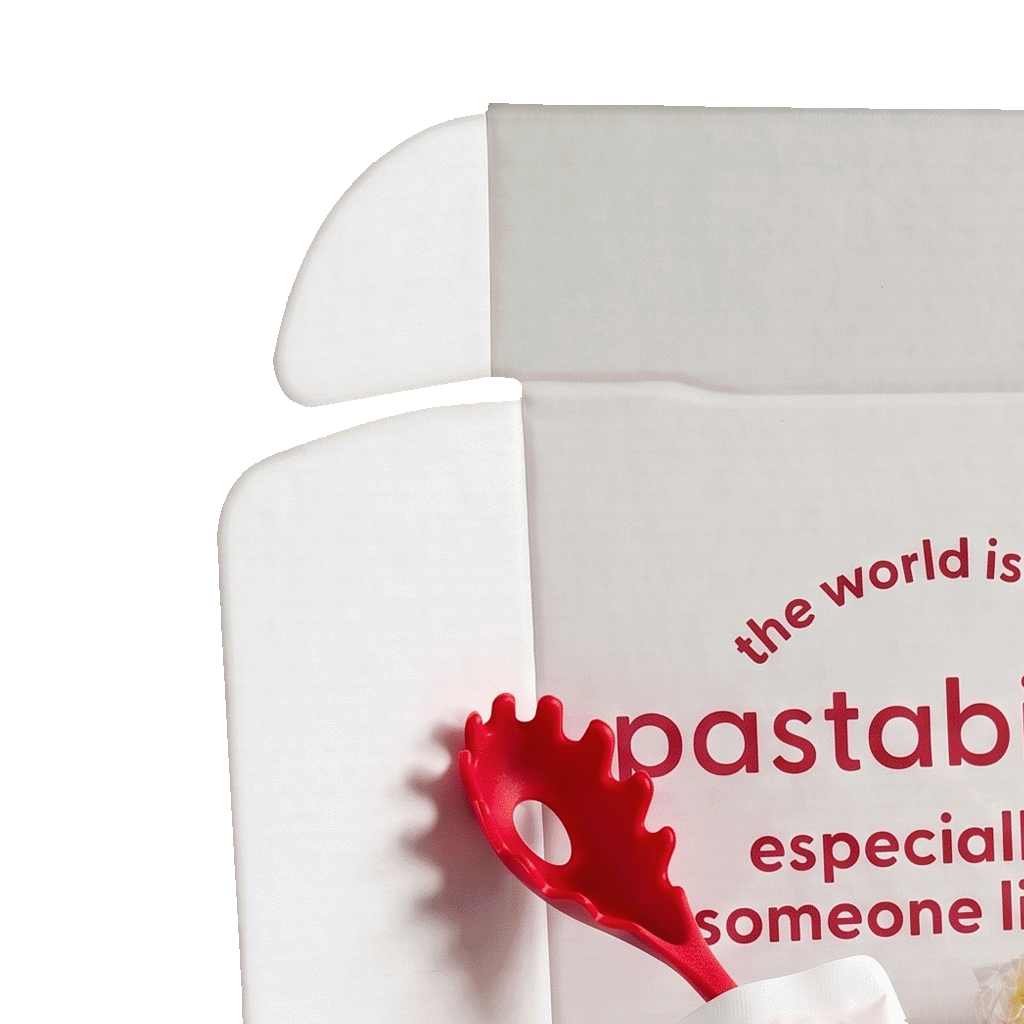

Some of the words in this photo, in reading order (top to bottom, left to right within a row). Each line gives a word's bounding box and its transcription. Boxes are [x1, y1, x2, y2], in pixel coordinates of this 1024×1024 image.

[735, 598, 815, 664] the
[820, 537, 969, 607] world
[987, 538, 1021, 583] is
[695, 895, 982, 946] someone
